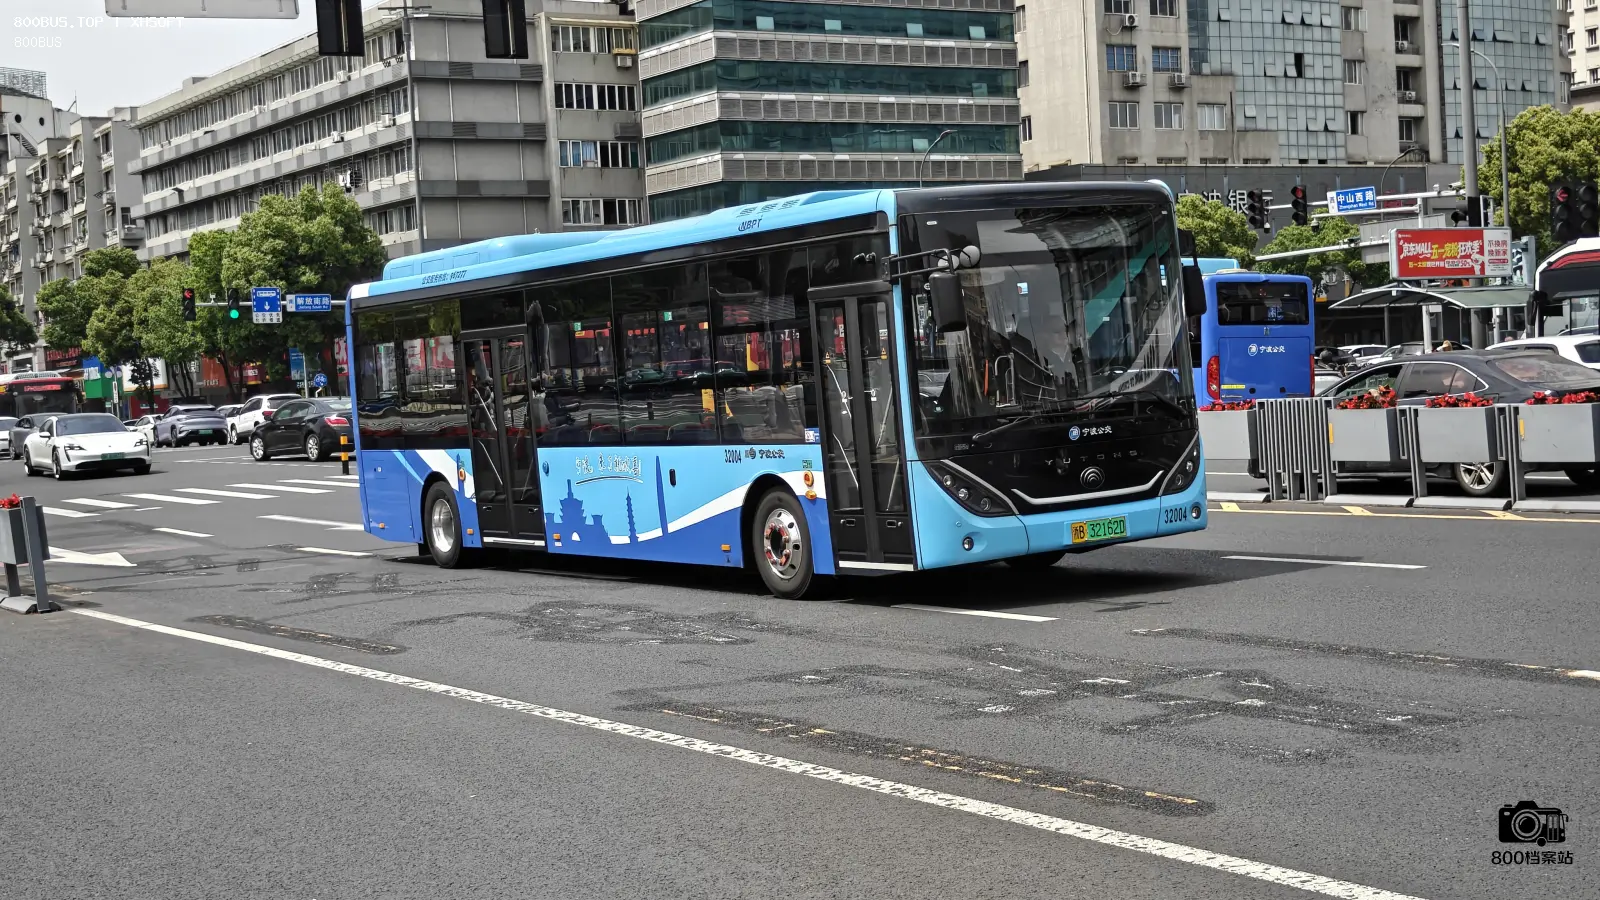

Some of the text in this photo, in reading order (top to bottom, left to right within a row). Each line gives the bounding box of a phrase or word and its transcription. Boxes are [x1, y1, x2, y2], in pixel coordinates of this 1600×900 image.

[1338, 191, 1374, 204] 中山西路
[296, 297, 329, 305] 解放南路
[1259, 345, 1285, 353] 宁波公交
[1082, 425, 1113, 437] 宁波公交
[724, 449, 742, 464] 32004
[758, 449, 786, 459] 宁波公交
[1045, 450, 1138, 466] YUTONG
[1164, 507, 1188, 524] 32004
